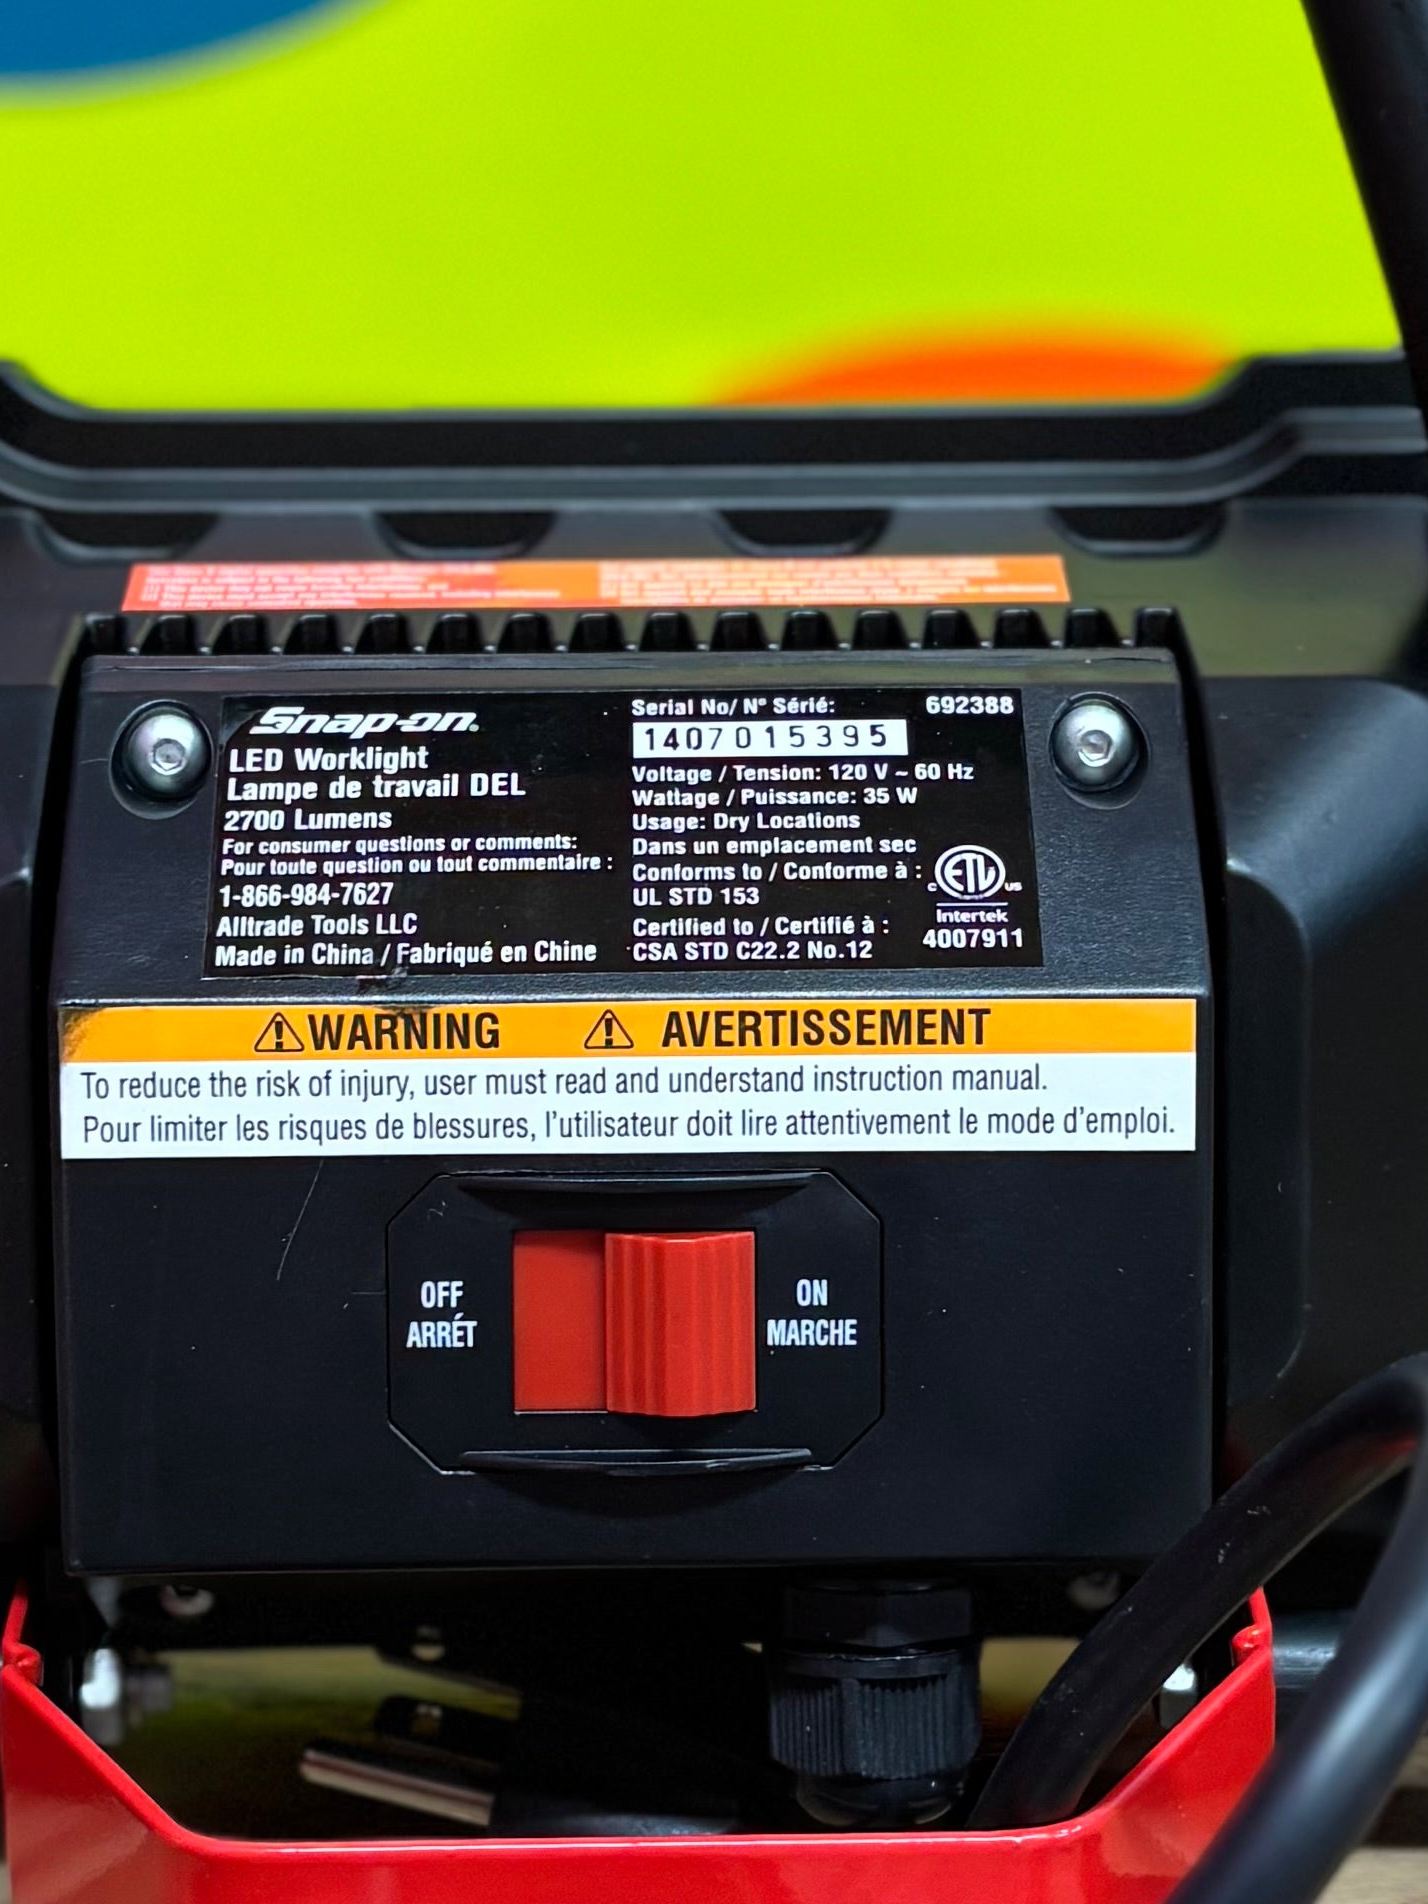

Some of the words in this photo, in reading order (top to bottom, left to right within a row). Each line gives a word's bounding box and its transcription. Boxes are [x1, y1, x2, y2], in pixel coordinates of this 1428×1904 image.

[632, 699, 693, 716] Serial
[701, 699, 737, 716] No/
[926, 696, 1014, 714] 692388
[646, 724, 886, 750] 1407015395
[230, 748, 283, 772] LED
[294, 746, 429, 774] Worklight
[632, 766, 712, 785] Voltage
[718, 766, 727, 782] /
[733, 764, 821, 781] Tension:
[829, 764, 867, 780] 120
[874, 763, 888, 780] V
[915, 763, 940, 780] 60
[948, 763, 974, 779] Hz
[227, 777, 318, 805] Lampe
[329, 775, 361, 798] de
[372, 773, 459, 798] travail
[471, 773, 526, 796] DEL
[632, 788, 719, 809] Wattage
[726, 789, 735, 806] /
[741, 788, 856, 805] Puissance:
[864, 788, 890, 804] 35
[896, 787, 917, 803] W
[224, 810, 284, 831] 2700
[295, 808, 392, 830] Lumens
[633, 814, 705, 833] Usage:
[714, 813, 749, 832] Dry
[757, 812, 860, 828] Locations
[223, 839, 254, 855] For
[259, 840, 351, 854] consumer
[356, 835, 445, 855] questions
[451, 838, 471, 851] or
[475, 834, 577, 850] comments:
[633, 838, 686, 855] Dans
[694, 841, 719, 854] un
[726, 837, 873, 857] emplacement
[879, 839, 916, 852] sec
[221, 859, 266, 875] Pour
[270, 859, 317, 875] toute
[323, 857, 403, 877] question
[409, 859, 431, 872] ou
[437, 856, 472, 872] tout
[478, 853, 601, 871] commentaire
[608, 857, 612, 869] :
[633, 863, 735, 881] Conforms
[742, 863, 762, 880] to
[769, 862, 777, 881] /
[784, 862, 888, 879] Conforme
[895, 861, 907, 879] à
[916, 866, 921, 878] :
[220, 882, 394, 907] 1-866-984-7627
[633, 888, 662, 906] UL
[669, 887, 712, 906] STD
[720, 887, 759, 905] 153
[216, 915, 304, 937] Alltrade
[311, 914, 369, 935] Tools
[376, 913, 417, 934] LLC
[633, 918, 725, 936] Certified
[733, 918, 753, 935] to
[760, 917, 769, 936] /
[775, 916, 855, 935] Certifié
[862, 915, 874, 934] à
[883, 920, 888, 933] :
[937, 909, 1008, 923] Intertek
[923, 928, 1022, 948] 4007911
[215, 945, 276, 966] Made
[284, 945, 304, 964] in
[312, 943, 373, 964] China
[380, 944, 391, 966] /
[397, 941, 493, 967] Fabriqué
[501, 946, 527, 962] en
[535, 940, 596, 962] Chine
[633, 942, 678, 961] CSA
[685, 942, 728, 960] STD
[736, 941, 800, 960] C22.2
[808, 940, 872, 959] No.12
[308, 1013, 499, 1050] WARNING
[662, 1009, 990, 1047] AVERTISSEMENT
[81, 1072, 108, 1098] To
[120, 1072, 200, 1098] reduce
[209, 1071, 246, 1097] the
[257, 1070, 299, 1097] risk
[309, 1070, 331, 1096] of
[342, 1070, 413, 1102] injury,
[425, 1075, 476, 1095] user
[486, 1070, 546, 1094] must
[557, 1068, 605, 1094] read
[616, 1067, 658, 1093] and
[670, 1066, 803, 1092] understand
[815, 1065, 941, 1091] instruction
[953, 1064, 1046, 1090] manual.
[84, 1116, 141, 1142] Pour
[151, 1115, 227, 1141] limiter
[237, 1115, 268, 1141] les
[280, 1114, 366, 1145] risques
[376, 1113, 403, 1139] de
[414, 1113, 535, 1141] blessures,
[547, 1111, 678, 1137] l'utilisateur
[688, 1110, 732, 1136] doit
[742, 1110, 776, 1135] lire
[787, 1109, 950, 1135] attentivement
[960, 1107, 977, 1133] le
[988, 1108, 1054, 1133] mode
[1064, 1107, 1173, 1138] d'emploi.
[421, 1281, 463, 1308] OFF
[797, 1279, 827, 1306] ON
[767, 1319, 857, 1346] MARCHE
